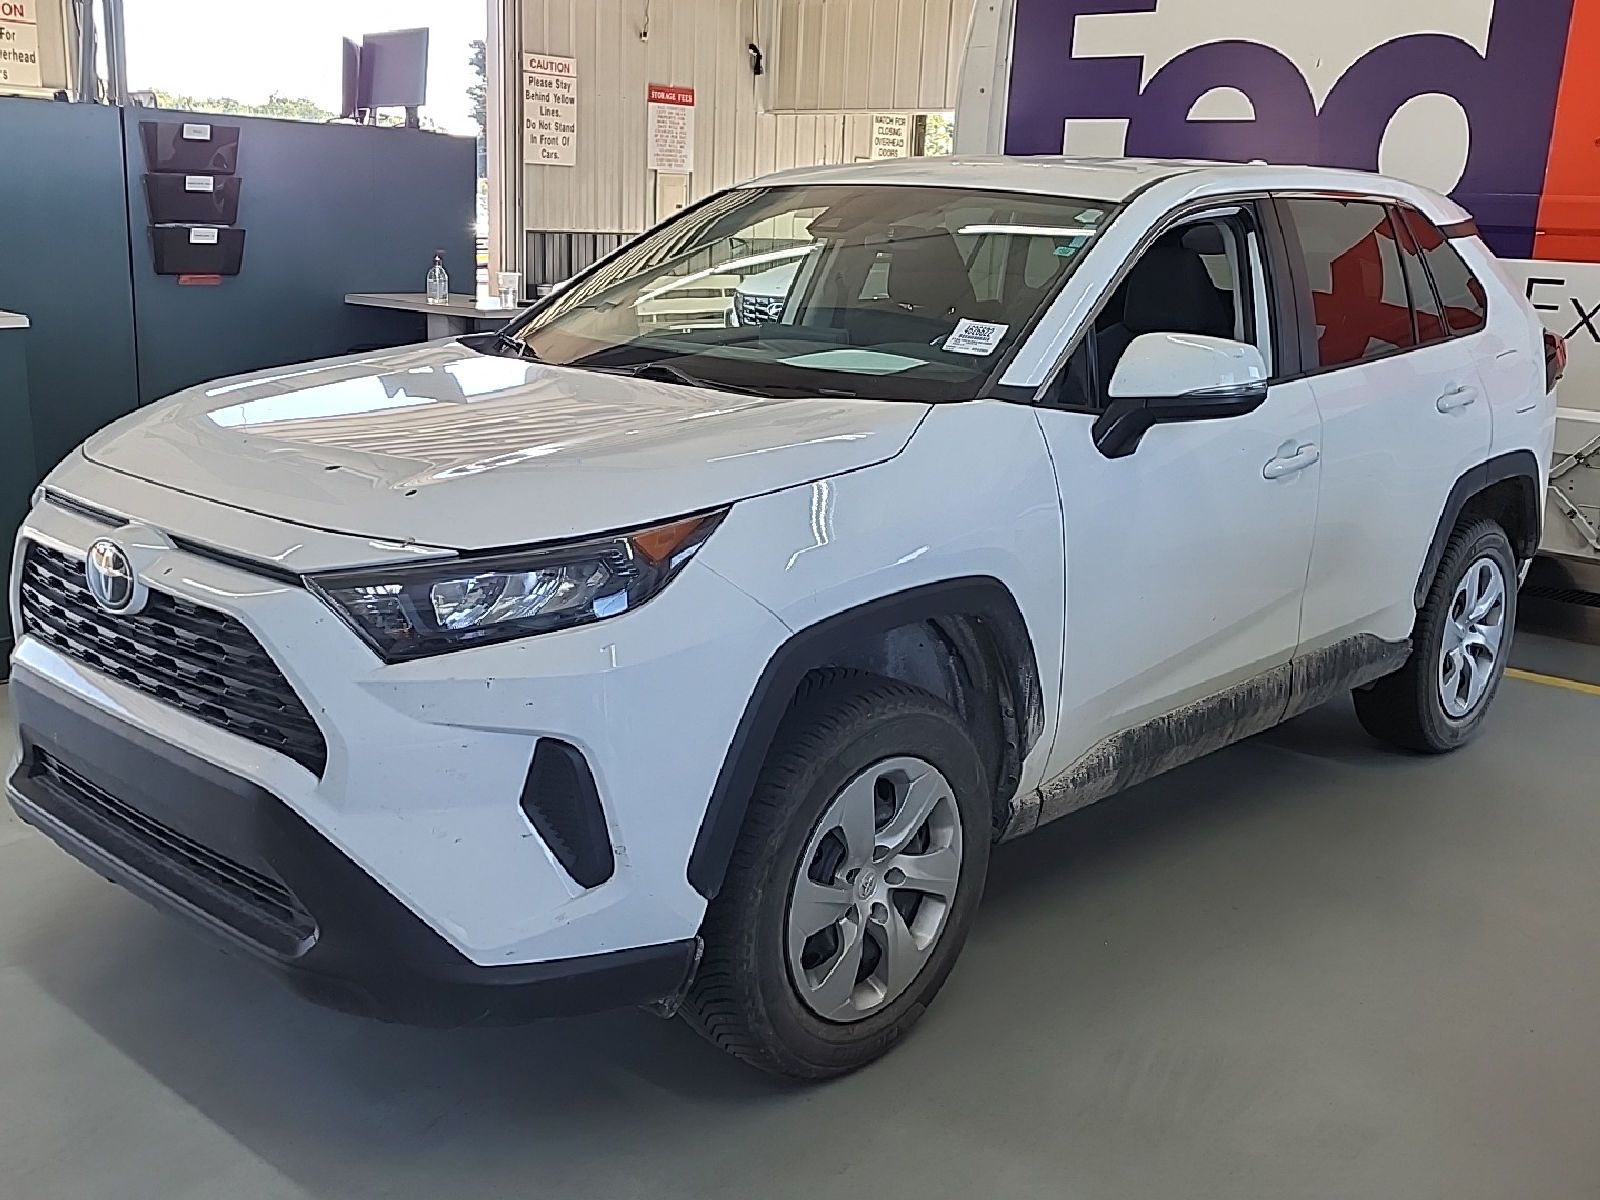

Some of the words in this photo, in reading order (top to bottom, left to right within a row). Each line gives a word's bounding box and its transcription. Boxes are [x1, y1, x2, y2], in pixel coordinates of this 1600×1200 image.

[0, 27, 16, 41] For
[0, 48, 36, 64] erhead
[529, 58, 570, 73] CAUTION
[528, 76, 553, 88] Please
[555, 78, 572, 93] Stay
[525, 89, 550, 103] Behind
[553, 93, 575, 105] Yellow
[651, 90, 677, 101] STORAGE
[539, 105, 561, 118] Lines.
[526, 118, 536, 130] Do
[538, 119, 551, 131] Not
[554, 121, 575, 133] Stand
[895, 116, 906, 126] FOR
[529, 133, 538, 144] In
[539, 134, 559, 146] Front
[561, 136, 570, 147] Of
[874, 137, 904, 148] OVERHEAD
[541, 148, 560, 160] Cars.
[878, 148, 898, 158] DOORS
